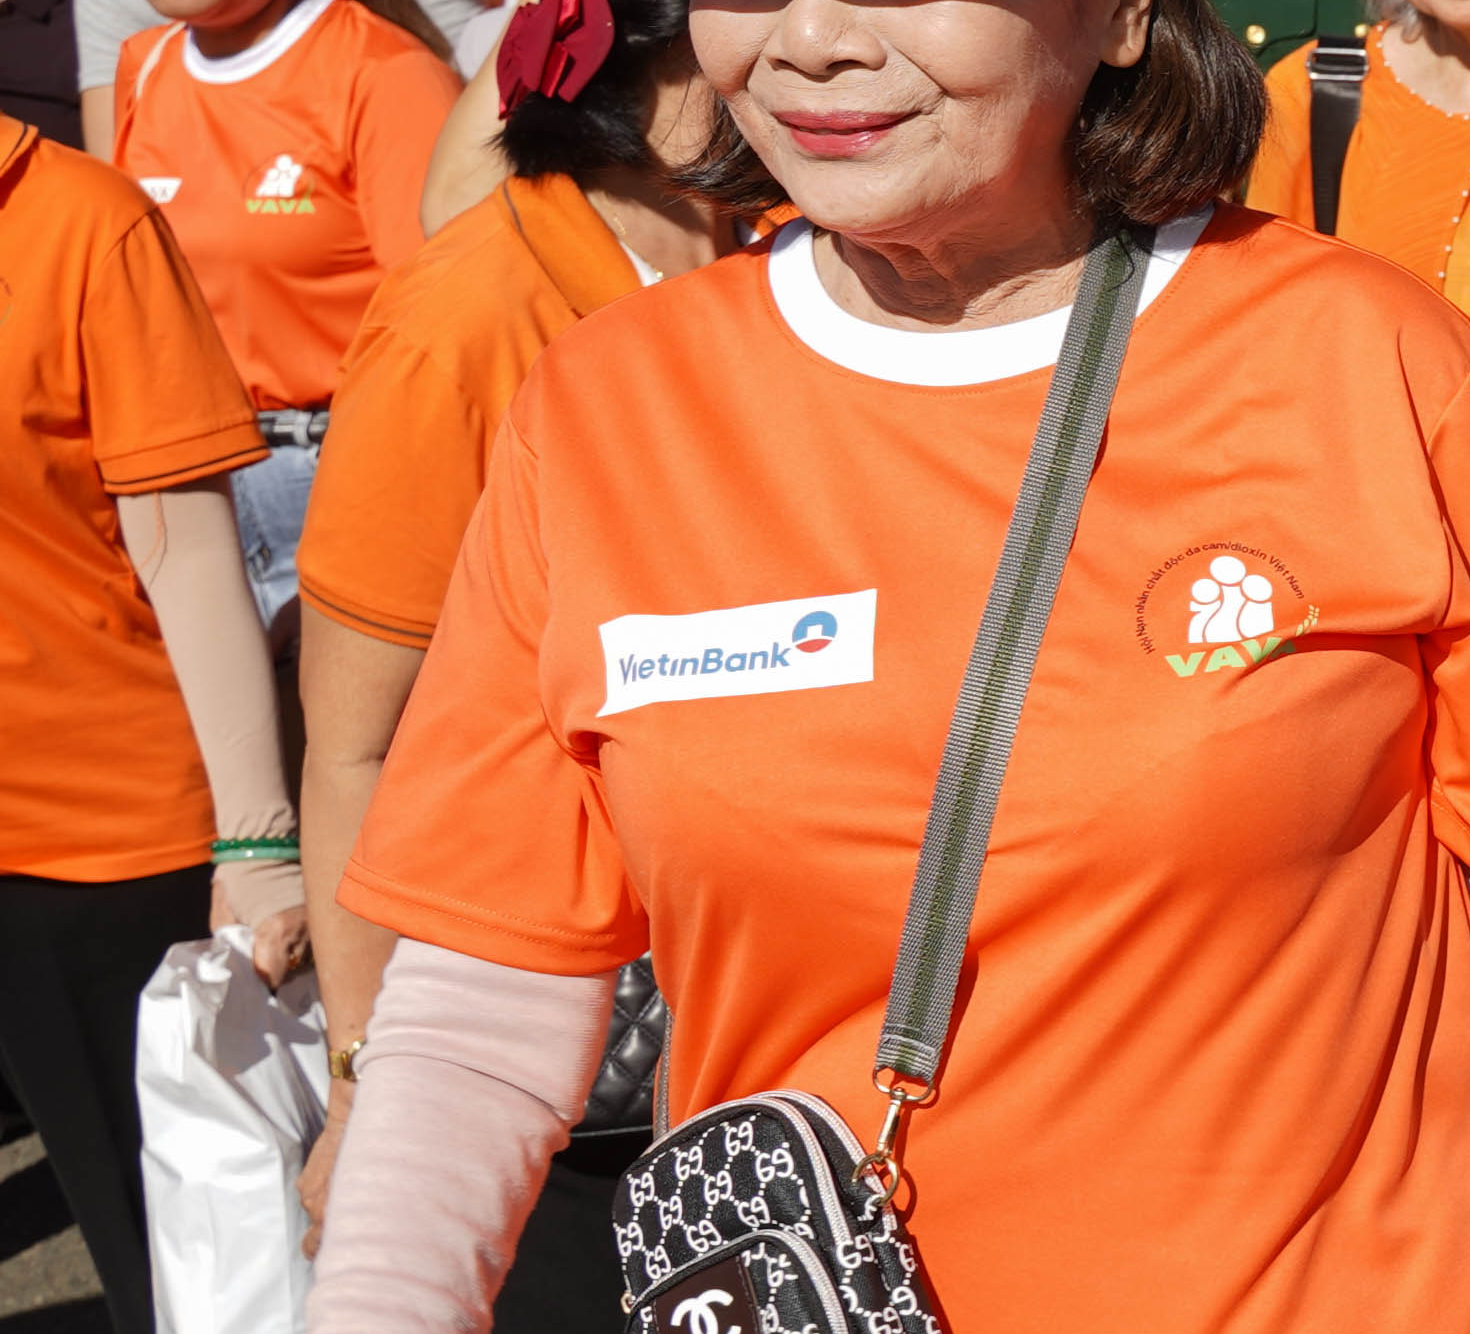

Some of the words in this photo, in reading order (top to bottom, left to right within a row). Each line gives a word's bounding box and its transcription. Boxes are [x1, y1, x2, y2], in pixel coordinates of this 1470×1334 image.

[245, 198, 316, 215] VAVA
[1186, 546, 1201, 557] da
[1286, 576, 1305, 600] Nam
[618, 642, 790, 686] VietinBank
